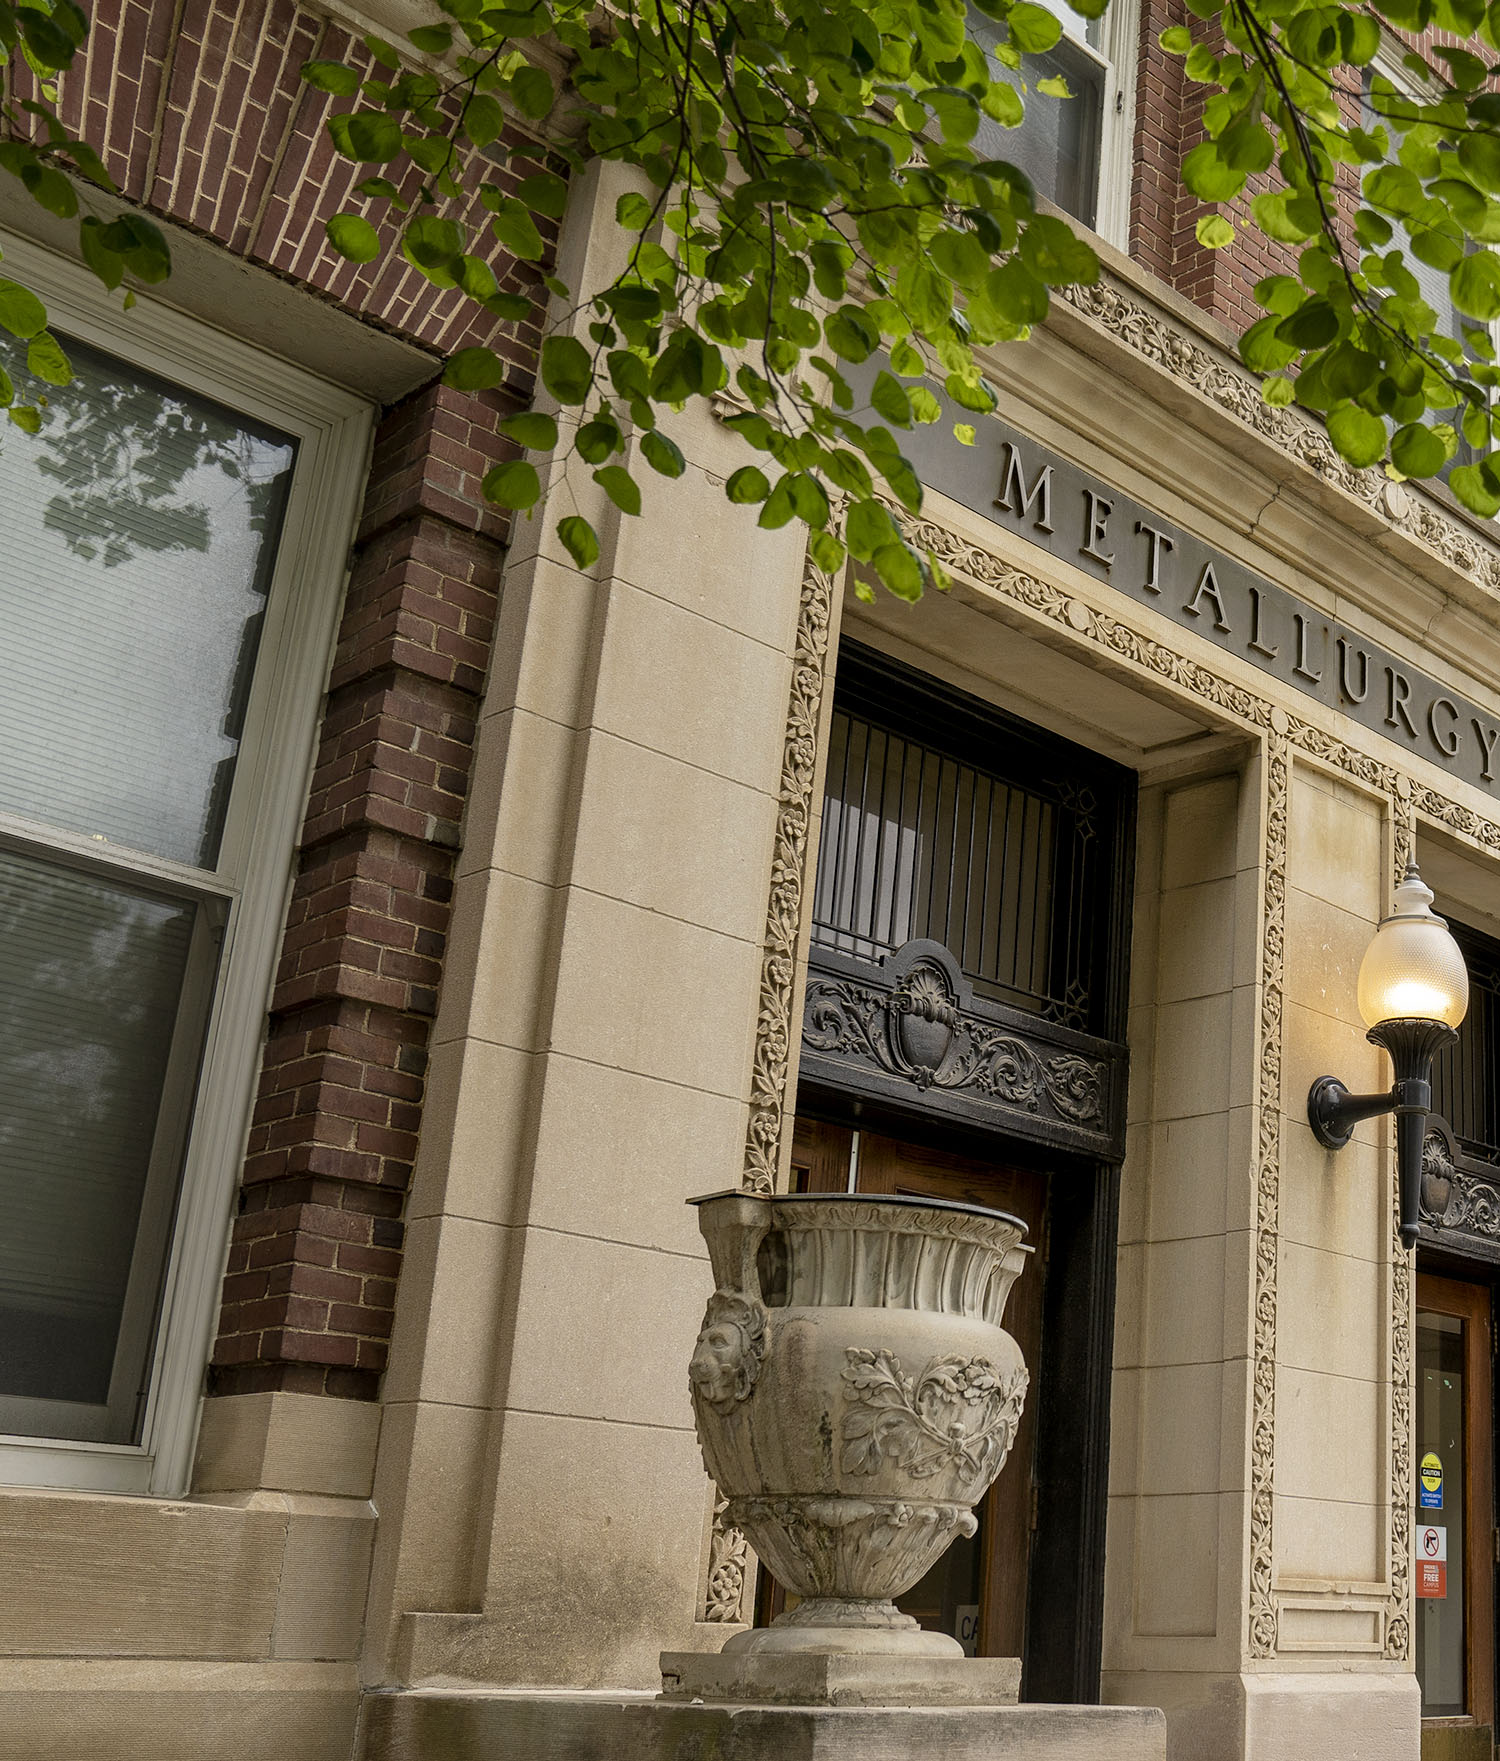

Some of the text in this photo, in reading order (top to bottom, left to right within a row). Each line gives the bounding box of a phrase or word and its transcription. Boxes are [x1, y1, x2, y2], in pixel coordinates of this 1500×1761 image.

[992, 442, 1500, 781] METALLURGY
[1422, 1468, 1441, 1477] CAUTION
[1423, 1573, 1439, 1582] FREE
